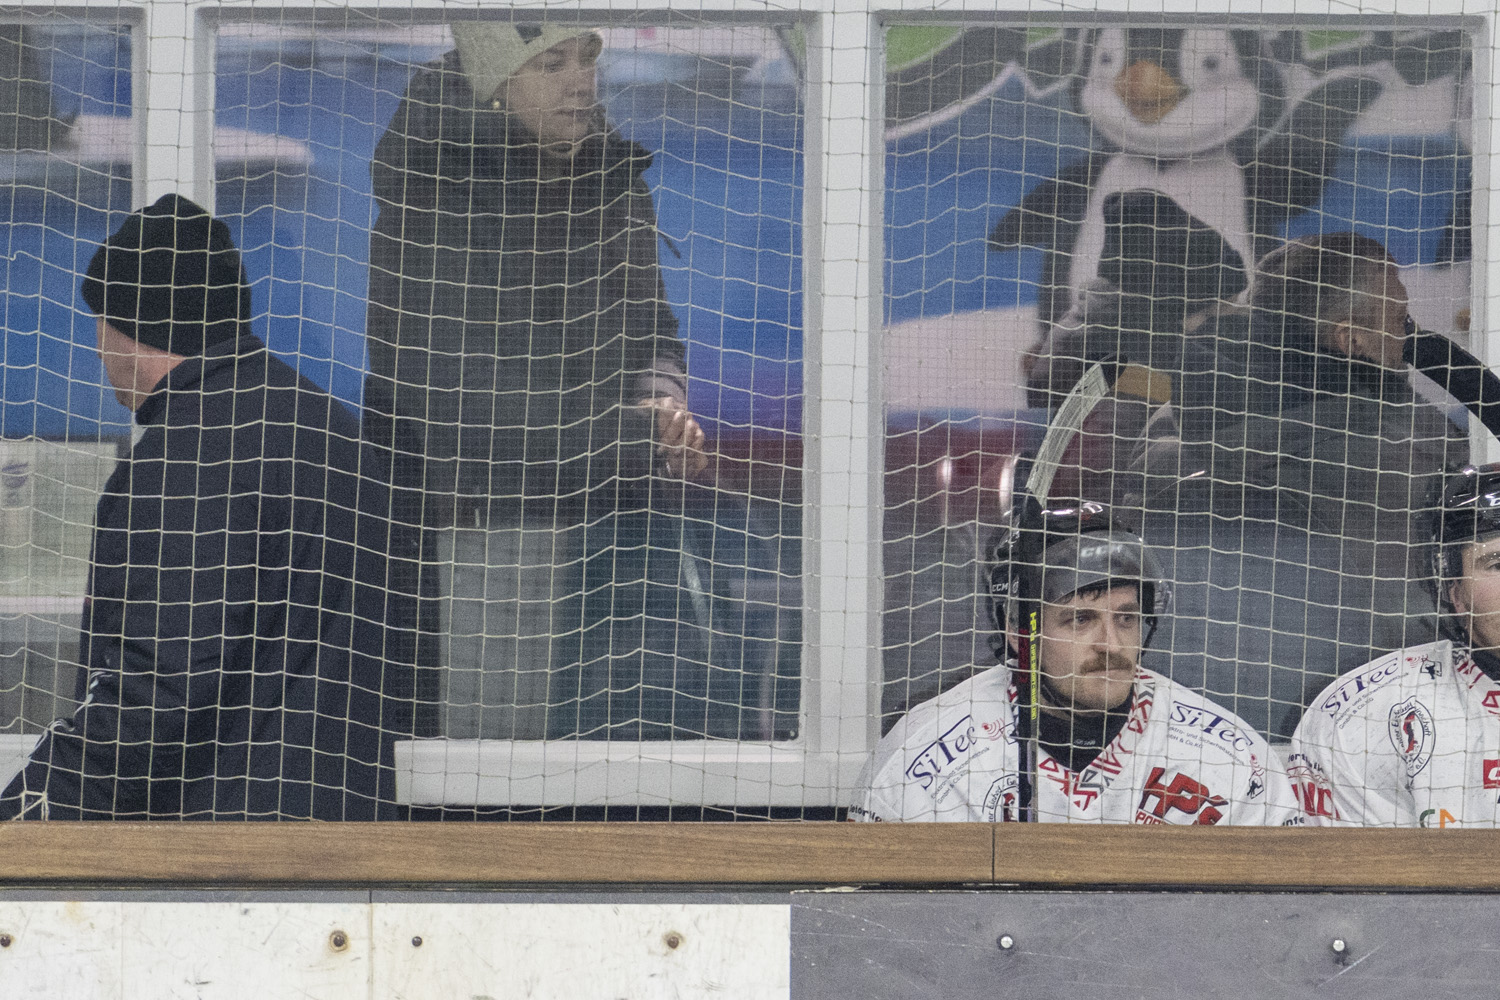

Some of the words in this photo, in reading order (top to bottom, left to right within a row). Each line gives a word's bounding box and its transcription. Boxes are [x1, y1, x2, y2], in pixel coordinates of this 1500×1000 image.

[1321, 657, 1400, 718] SiTec
[906, 714, 978, 790] SiTec
[1169, 701, 1254, 752] SiTec
